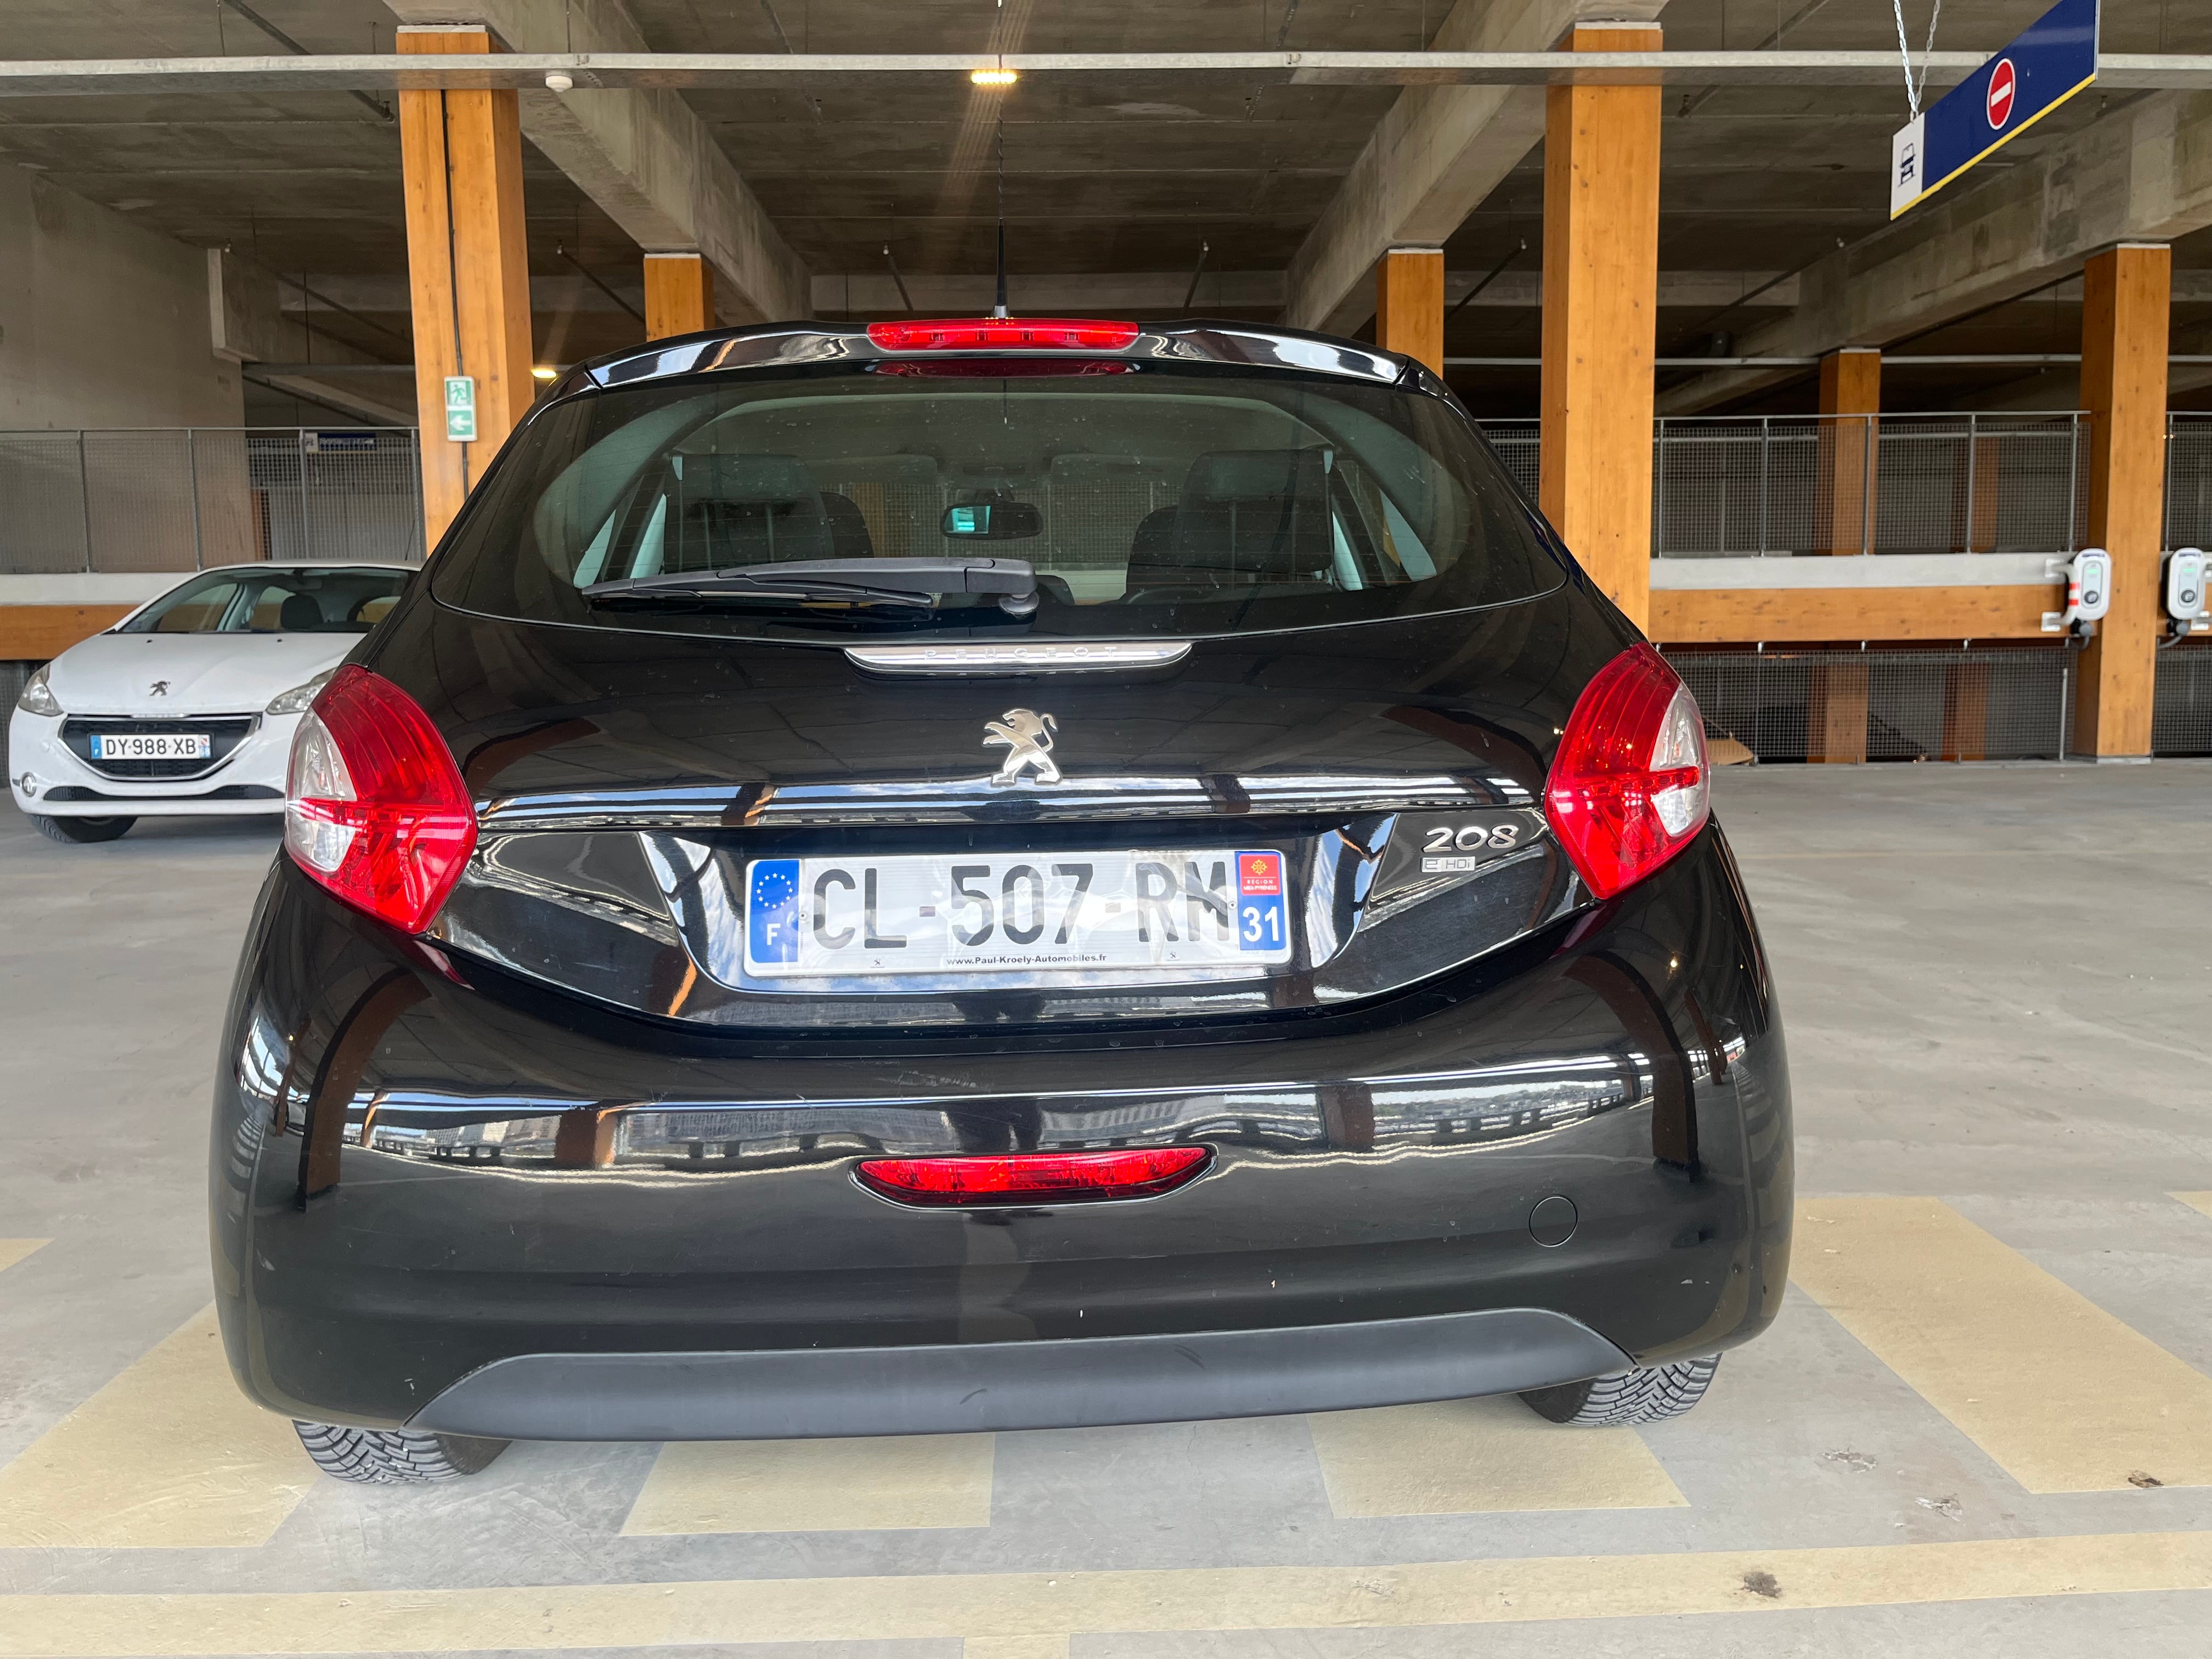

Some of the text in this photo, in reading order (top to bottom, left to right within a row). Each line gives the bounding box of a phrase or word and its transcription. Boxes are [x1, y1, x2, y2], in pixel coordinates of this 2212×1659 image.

[924, 646, 1117, 659] PEUGEOT
[106, 738, 196, 754] DY-988-XB
[1423, 825, 1519, 853] 208
[813, 861, 1229, 950] CL-507-RM
[766, 923, 781, 946] F
[1243, 906, 1279, 942] 31
[947, 955, 1107, 964] www.Paul-Kroely-Automobiles.fr
